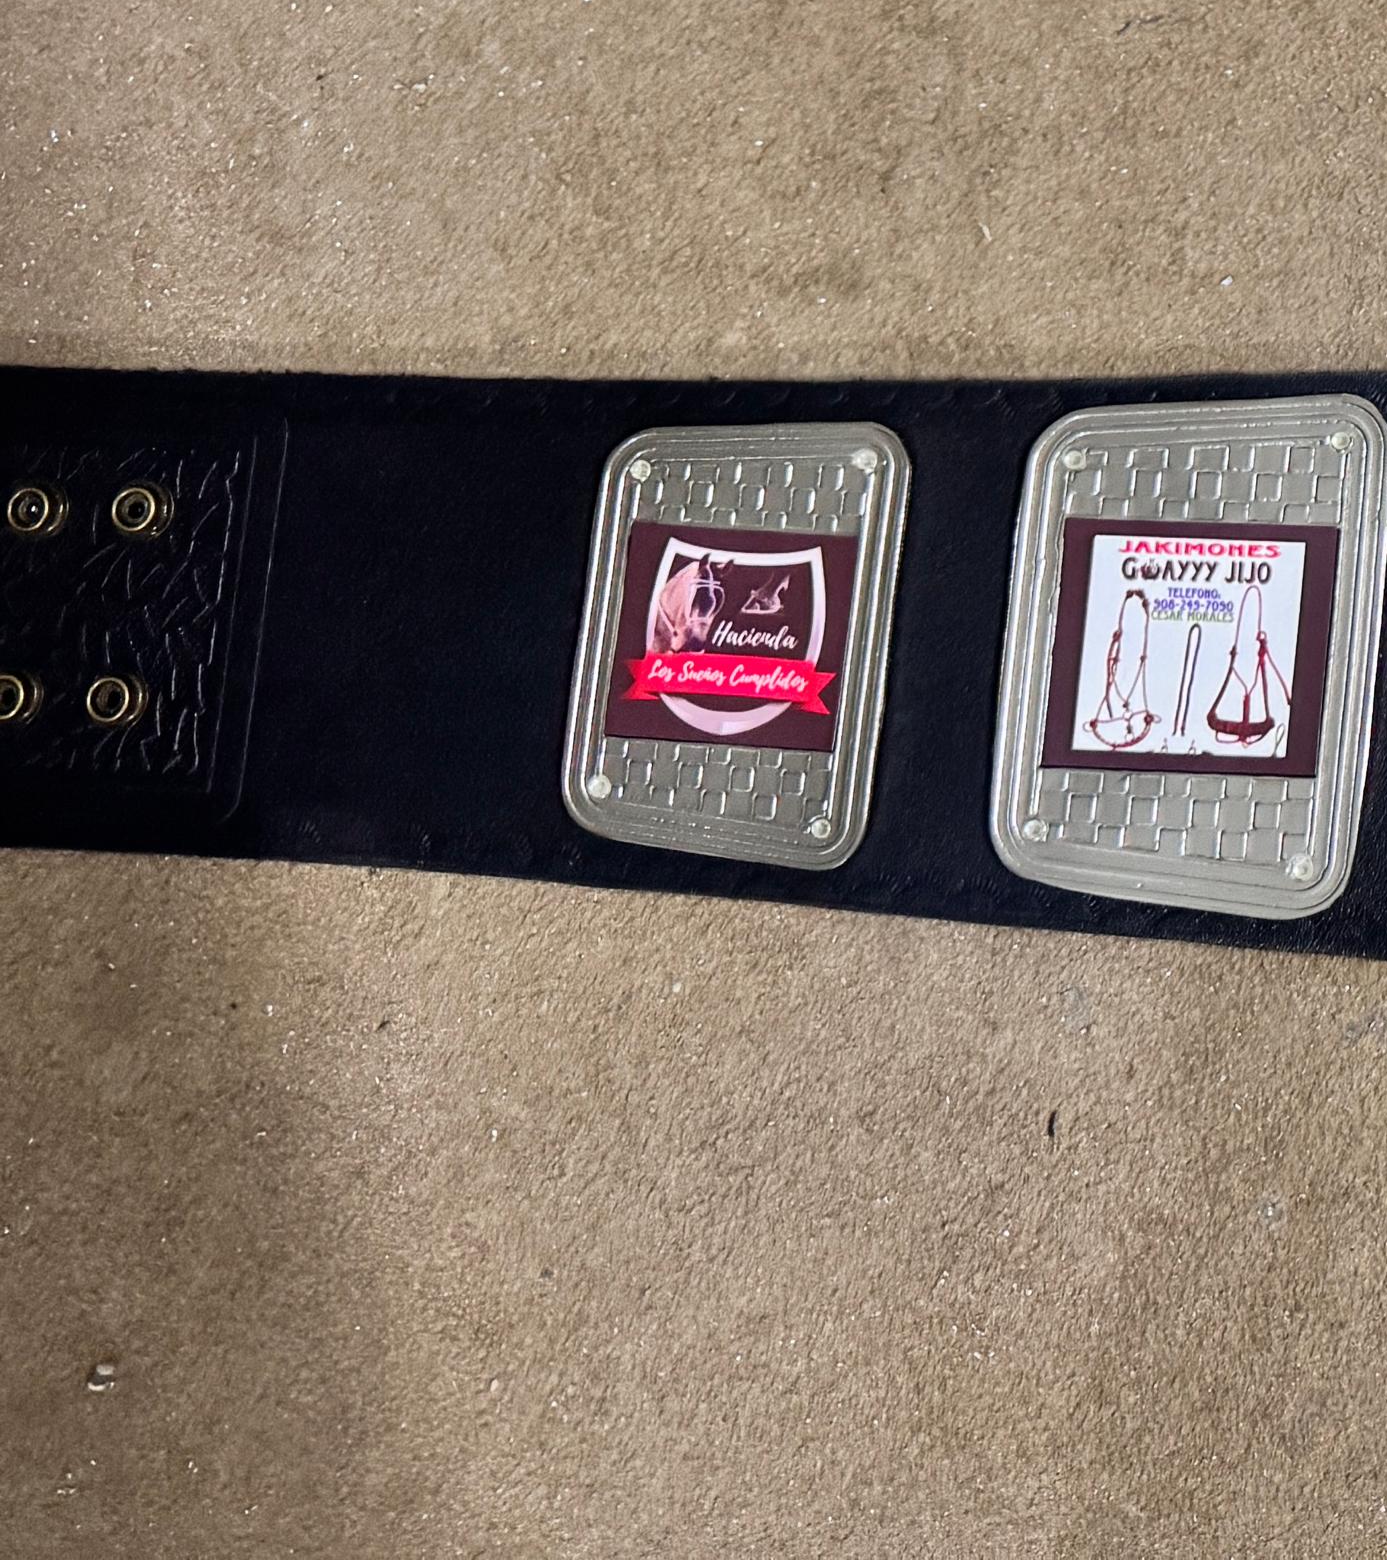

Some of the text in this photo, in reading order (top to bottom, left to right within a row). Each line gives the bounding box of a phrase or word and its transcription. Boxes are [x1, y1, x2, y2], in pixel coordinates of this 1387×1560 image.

[1225, 561, 1272, 585] JIJO
[1187, 610, 1235, 622] MORALES
[712, 620, 799, 650] Hacienda
[648, 659, 809, 693] Los Sueños Cumplidos
